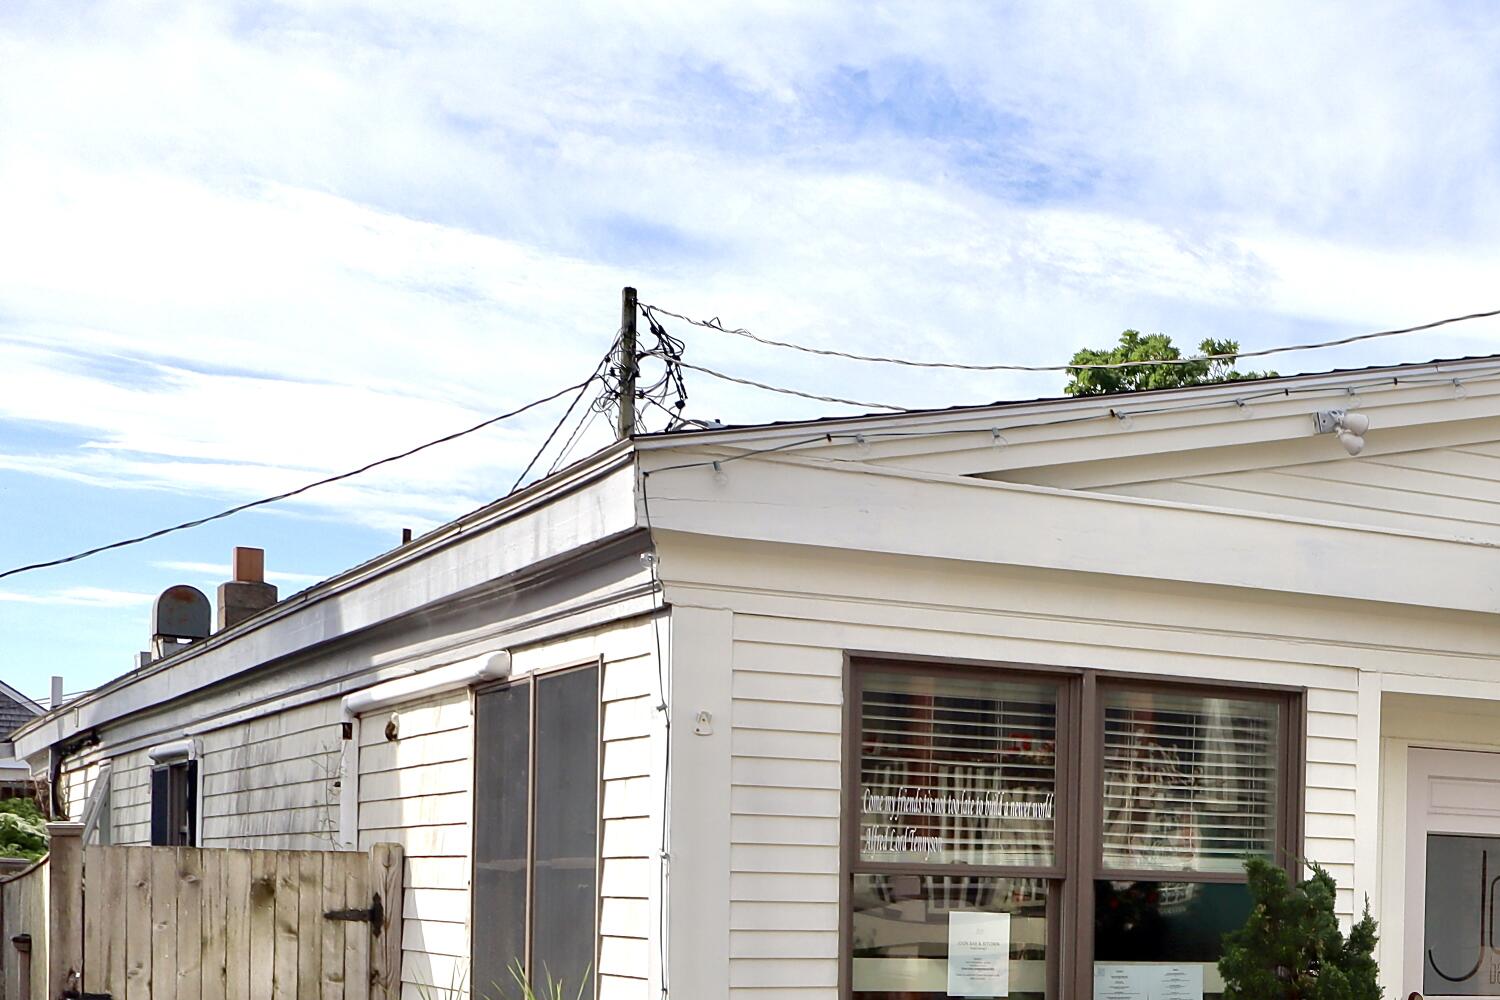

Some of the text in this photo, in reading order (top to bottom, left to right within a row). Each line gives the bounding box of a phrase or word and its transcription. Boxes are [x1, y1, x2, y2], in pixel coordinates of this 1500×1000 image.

[863, 788, 883, 814] Come
[884, 795, 896, 821] my
[894, 787, 922, 821] friends
[934, 795, 946, 815] not
[948, 795, 960, 815] too
[961, 789, 975, 816] late
[976, 796, 984, 816] to
[985, 791, 1005, 816] build
[1003, 801, 1009, 817] a
[1011, 801, 1031, 818] newer
[1032, 793, 1054, 819] world
[862, 825, 943, 861] Alfred Lord Tennyson
